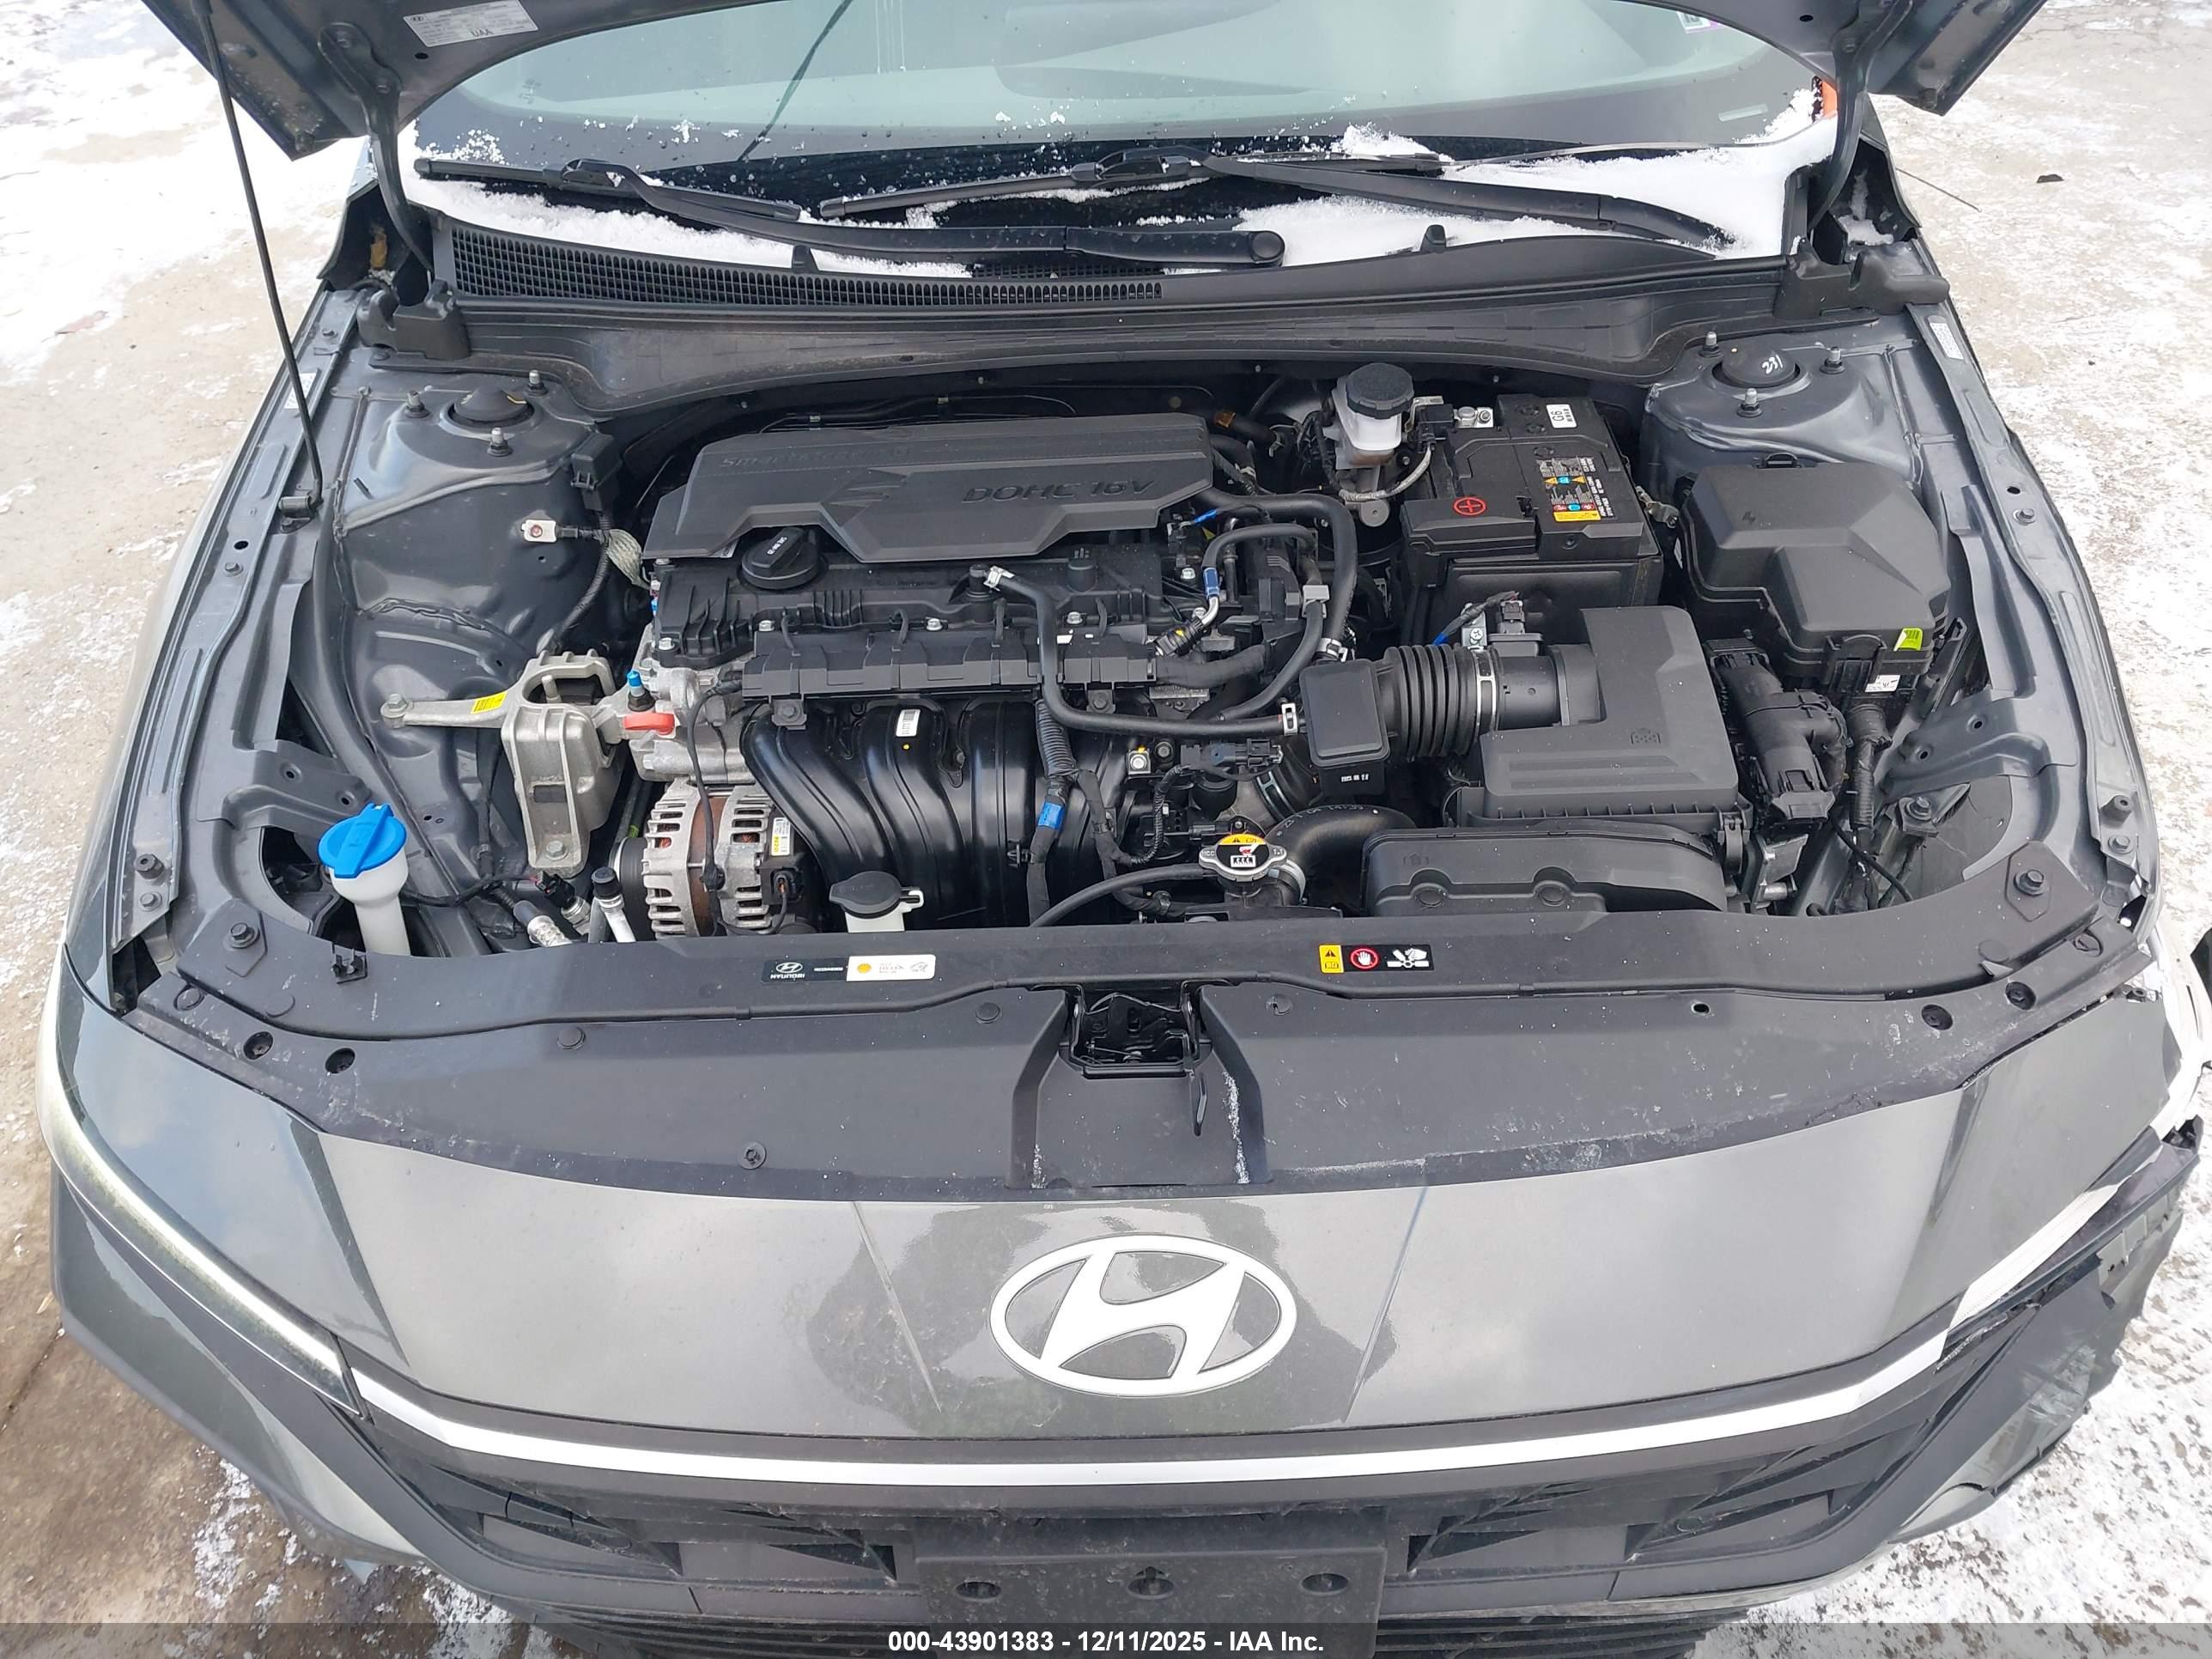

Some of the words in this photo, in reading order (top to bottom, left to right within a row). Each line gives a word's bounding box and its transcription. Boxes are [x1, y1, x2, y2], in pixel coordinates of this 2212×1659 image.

[472, 28, 493, 38] UAA
[1551, 410, 1565, 422] G6
[962, 483, 1081, 503] DOHC
[1091, 480, 1155, 496] 16V
